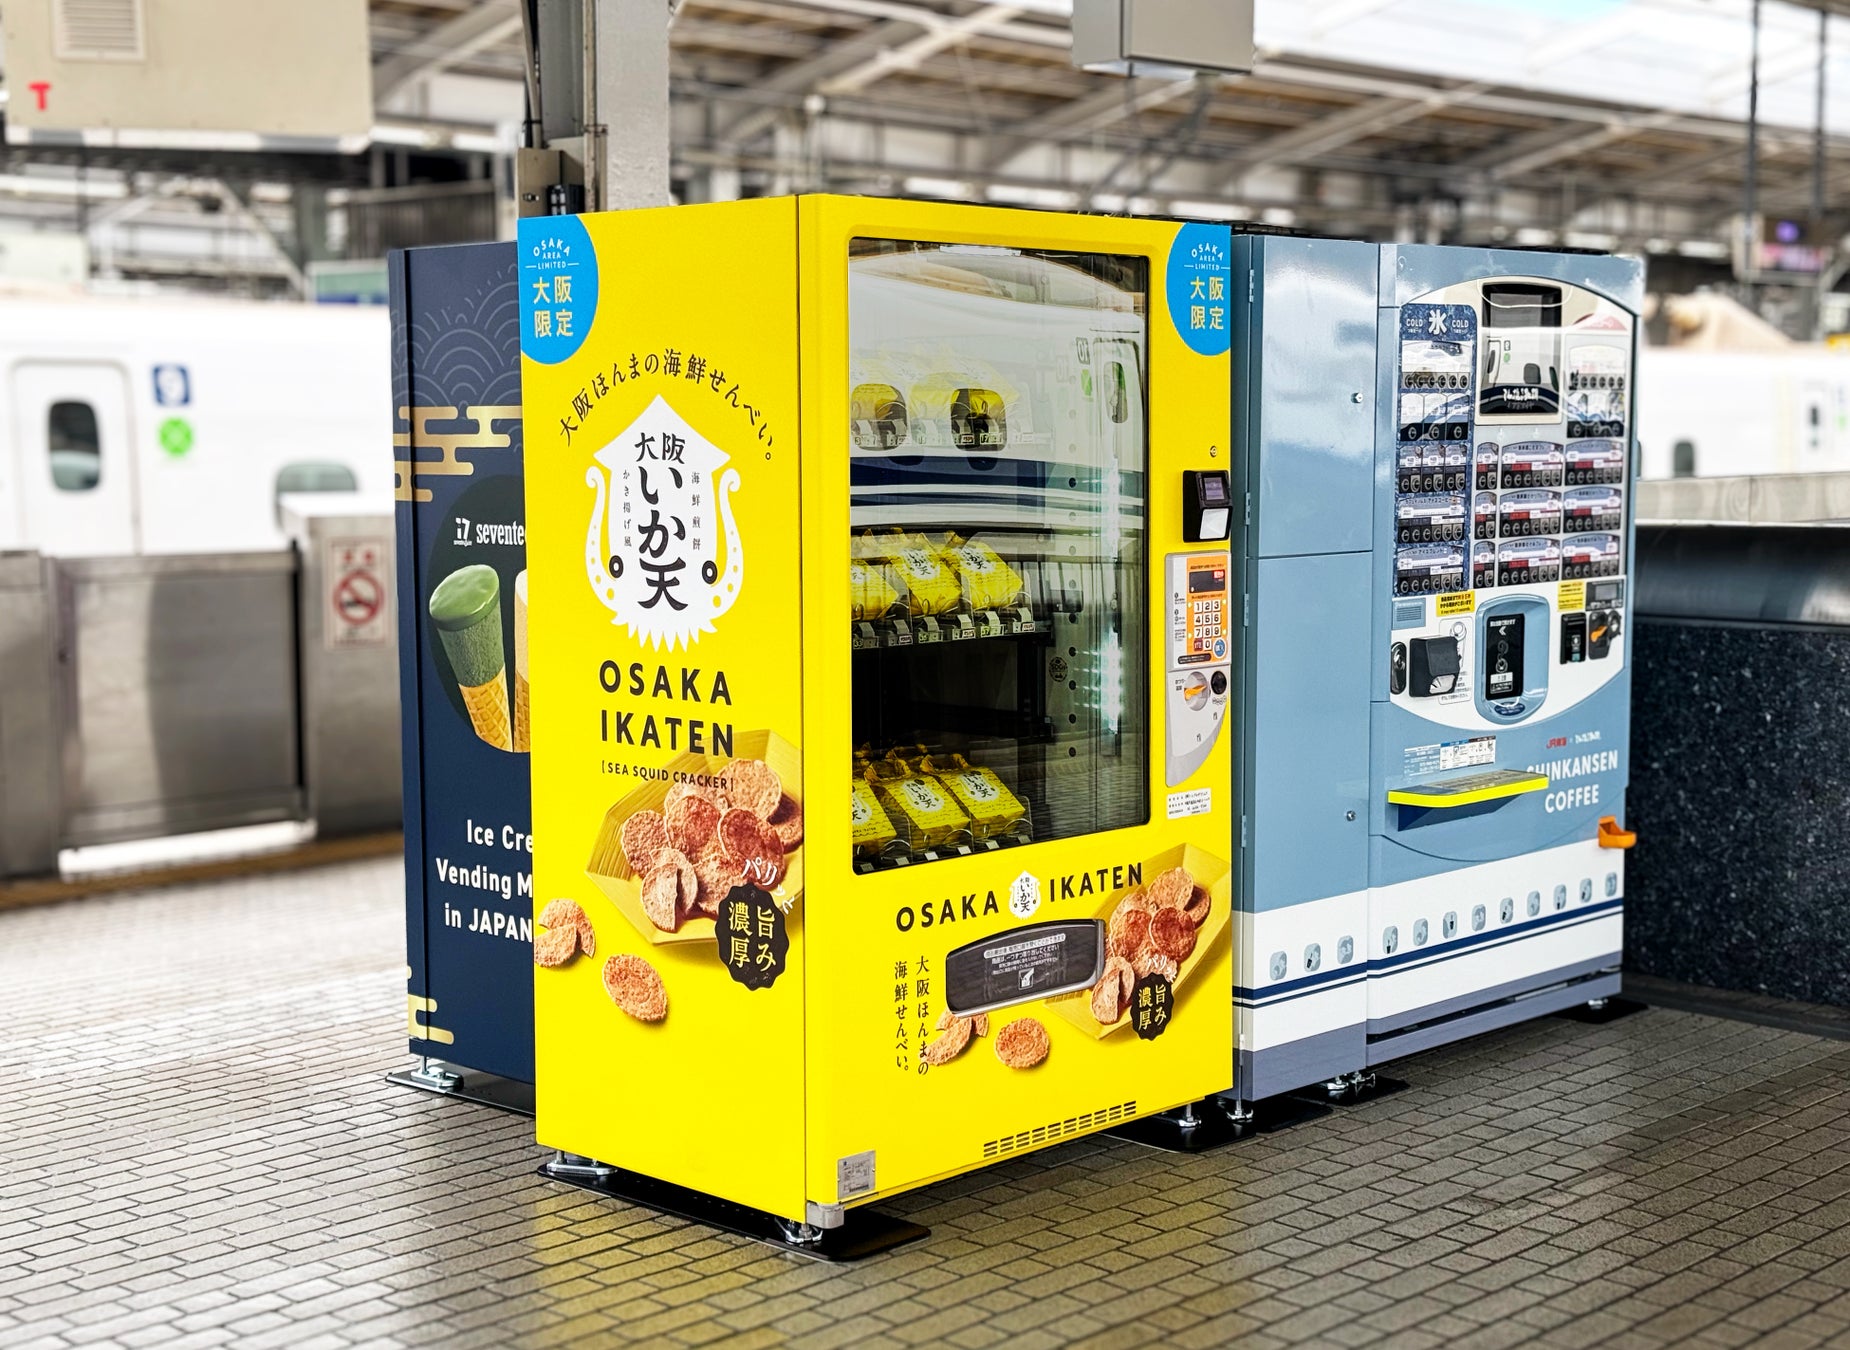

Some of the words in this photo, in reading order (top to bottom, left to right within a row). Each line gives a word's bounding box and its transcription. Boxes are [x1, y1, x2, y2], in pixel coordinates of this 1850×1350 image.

[28, 81, 51, 111] T
[533, 238, 571, 258] OSAKA
[538, 260, 567, 270] LIMITED
[1191, 243, 1224, 261] OSAKA
[1194, 263, 1220, 271] LIMITED
[532, 275, 573, 304] 大阪
[1190, 275, 1225, 301] 大阪
[534, 309, 574, 338] 限定
[1190, 305, 1225, 330] 限定
[1406, 318, 1423, 327] COLD
[1428, 309, 1447, 335] 氷
[1452, 319, 1469, 328] COLD
[559, 349, 775, 461] 大阪ほんまの海鮮せんべい。
[634, 432, 686, 464] 大阪
[623, 470, 632, 547] かき揚げ風
[691, 472, 701, 551] 海鮮煎餅
[638, 466, 688, 611] いか天
[599, 659, 732, 706] OSAKA
[601, 709, 734, 758] IKATEN
[633, 766, 669, 781] SQUID
[1545, 784, 1599, 814] COFFEE
[467, 819, 494, 847] Ice
[502, 825, 533, 853] Cre
[436, 858, 512, 900] Vending
[518, 872, 533, 898] M
[896, 890, 999, 932] OSAKA
[1049, 862, 1143, 902] IKATEN
[445, 902, 462, 928] in
[469, 909, 533, 943] JAPAN
[728, 901, 752, 969] 濃厚
[755, 905, 776, 972] 旨み
[892, 960, 909, 1071] 海鮮せんべい。
[916, 955, 930, 1076] 大阪ほんまの
[1138, 987, 1153, 1031] 濃厚
[1154, 984, 1167, 1026] 旨み
